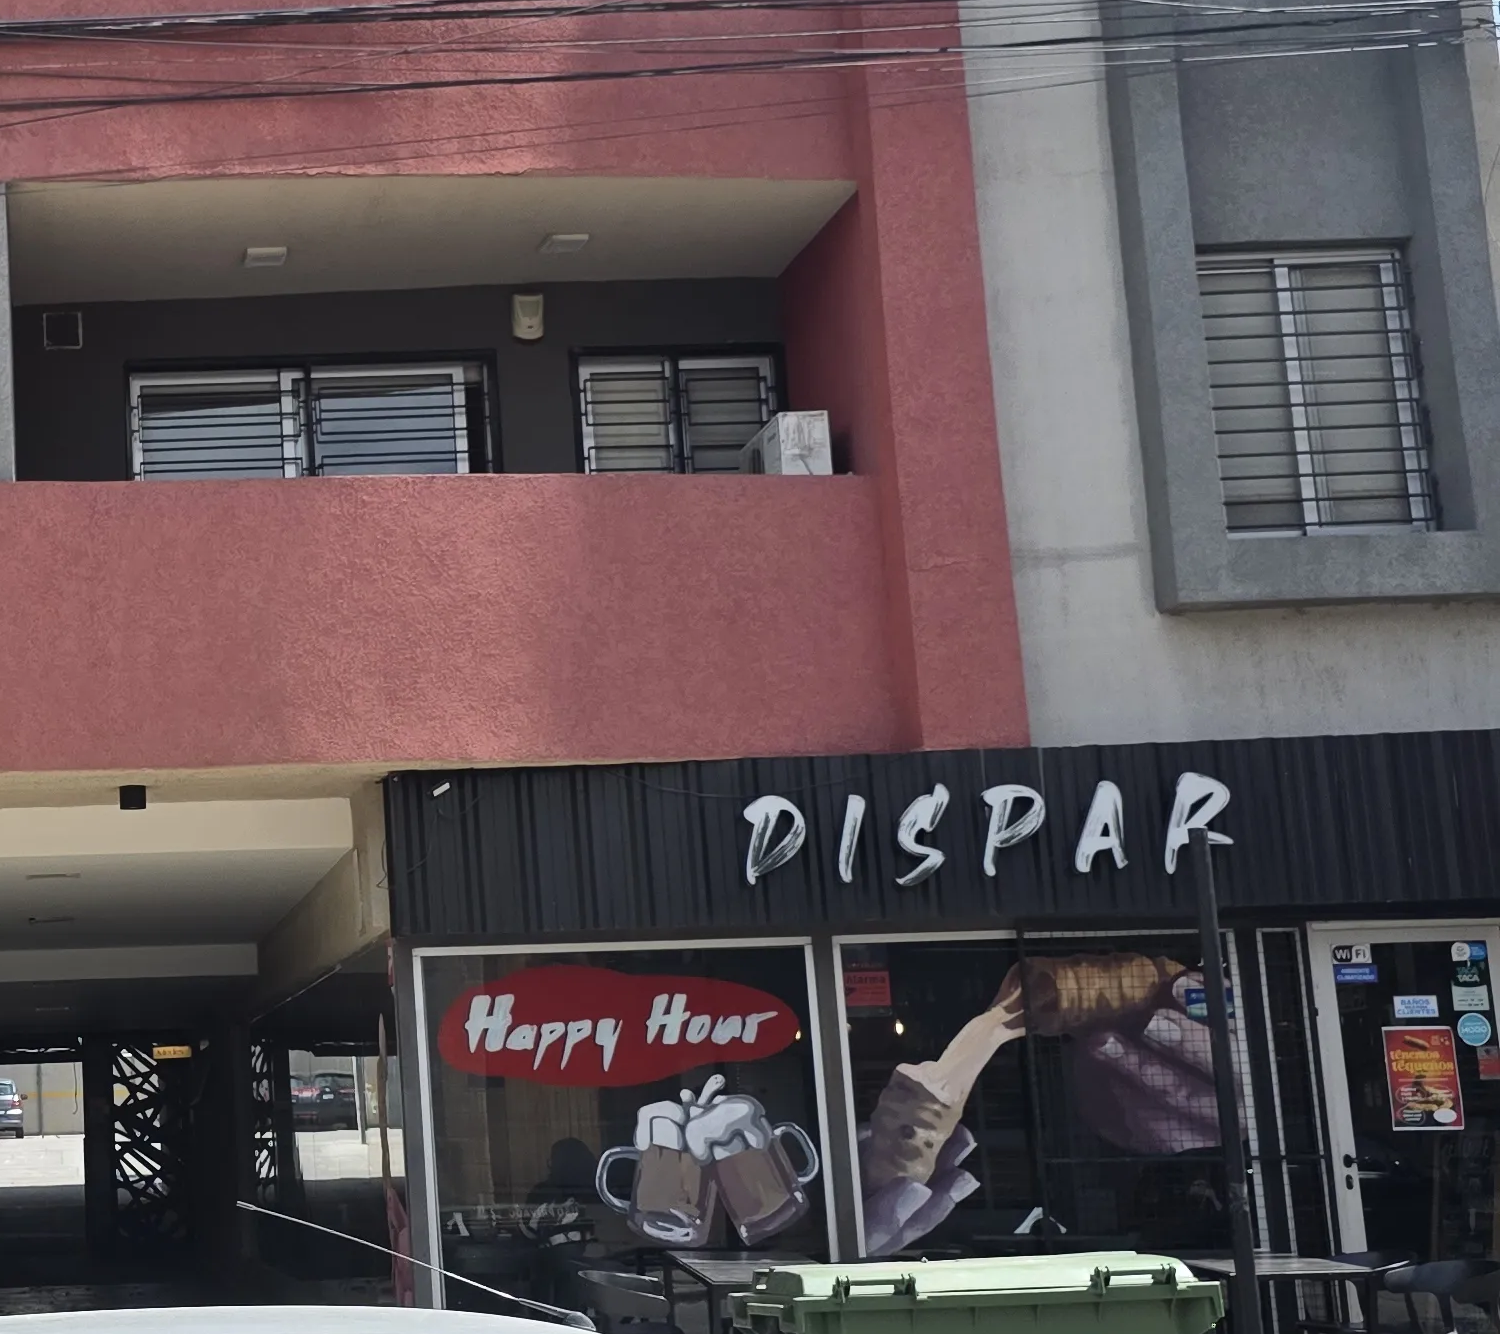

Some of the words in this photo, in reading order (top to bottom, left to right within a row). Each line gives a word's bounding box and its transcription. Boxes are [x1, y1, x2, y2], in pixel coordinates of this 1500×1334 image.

[743, 771, 1235, 886] DISPAR
[464, 993, 623, 1072] Happy
[646, 992, 779, 1045] Hour
